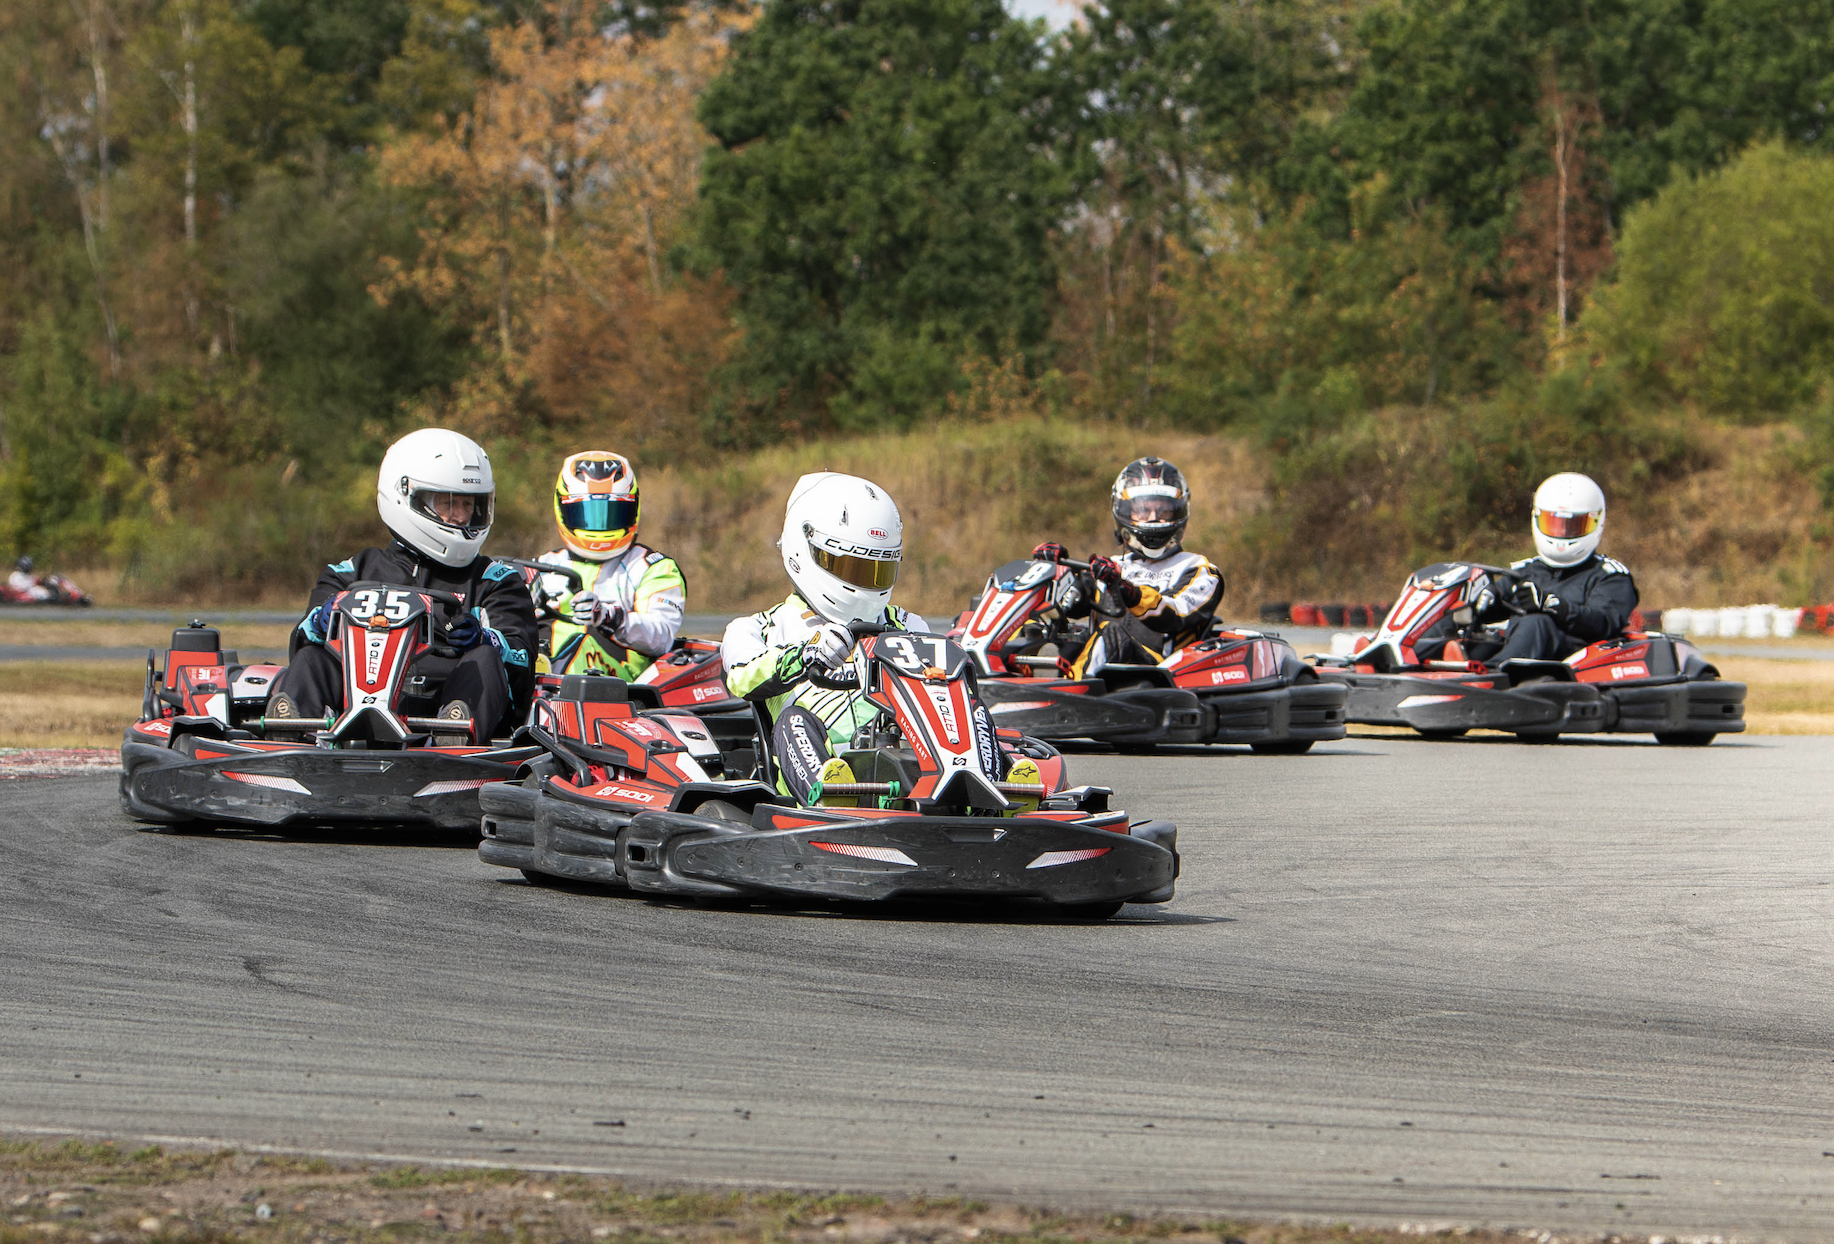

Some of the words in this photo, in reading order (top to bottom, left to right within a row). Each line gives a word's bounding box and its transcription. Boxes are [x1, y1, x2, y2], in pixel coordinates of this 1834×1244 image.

[870, 529, 886, 537] BELL
[351, 590, 411, 620] 35
[885, 636, 947, 670] 37
[900, 716, 917, 743] RACING
[915, 742, 928, 761] KART
